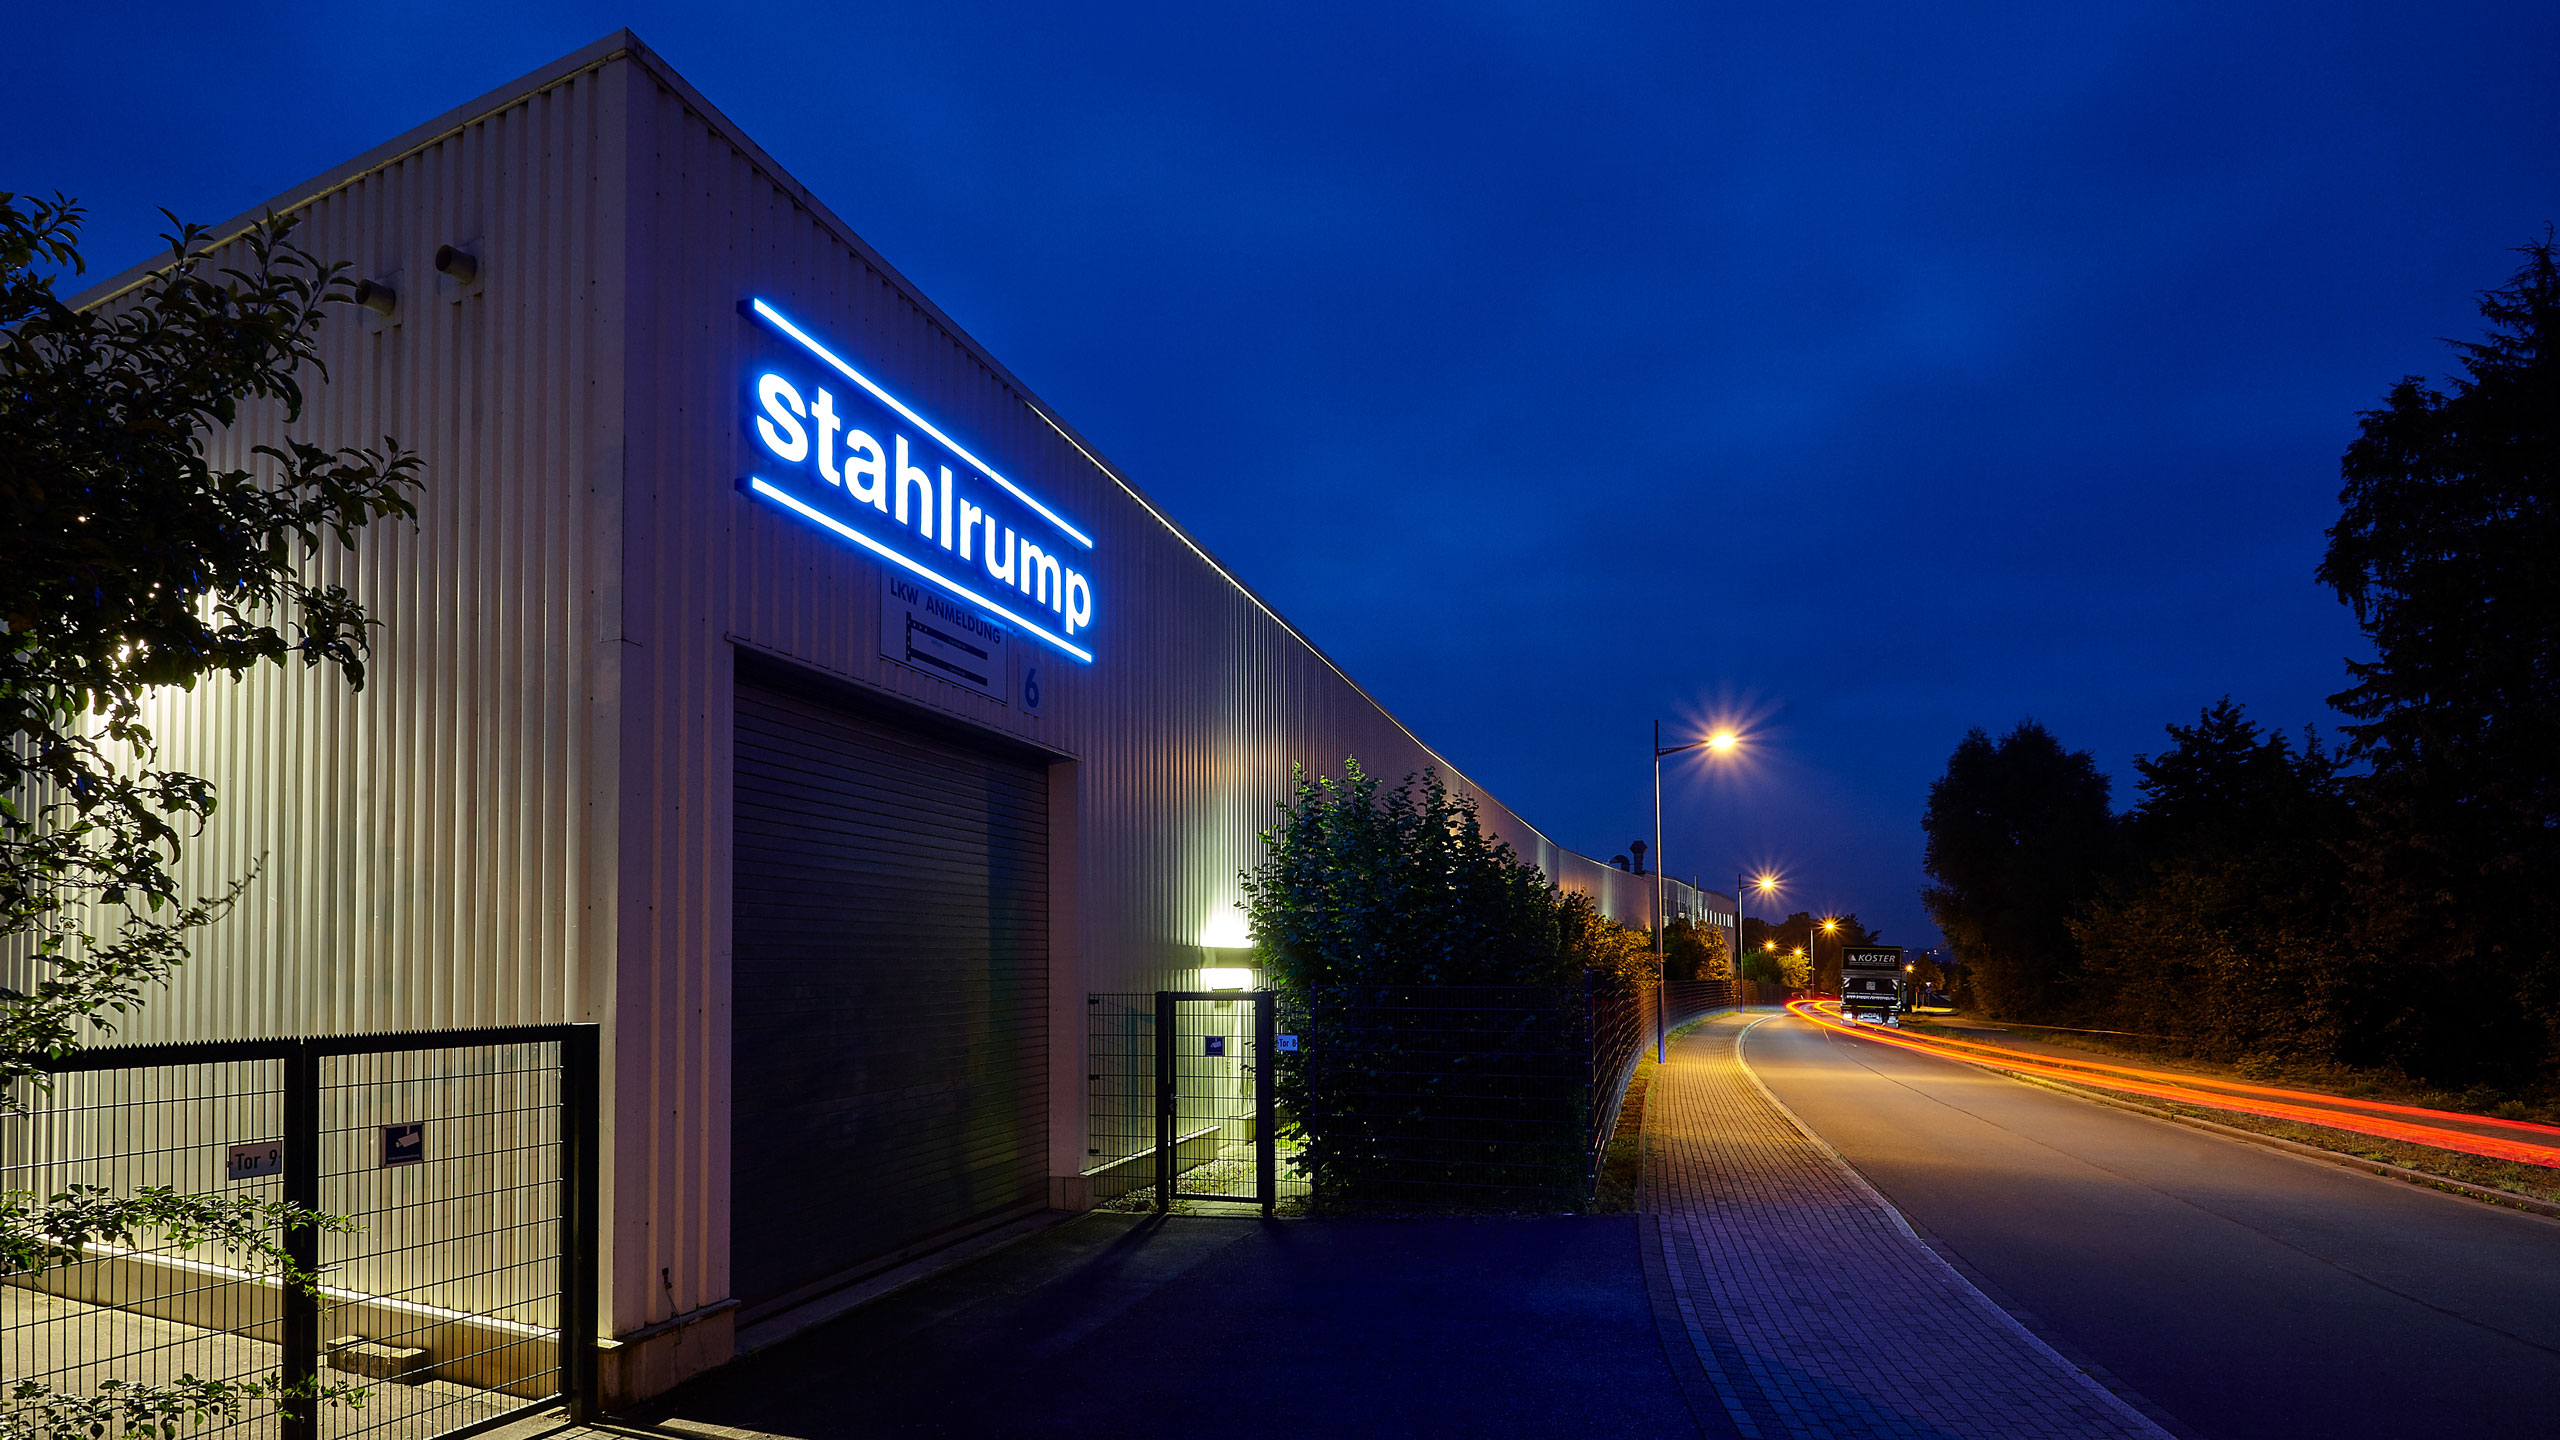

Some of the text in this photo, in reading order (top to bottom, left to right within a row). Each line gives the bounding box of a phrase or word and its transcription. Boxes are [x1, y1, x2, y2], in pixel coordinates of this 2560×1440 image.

[757, 373, 1092, 635] stahlrump
[890, 577, 1001, 644] LKW ANMELDUNG
[1025, 668, 1040, 709] 6
[1858, 952, 1896, 963] KÖSTER
[1279, 1038, 1290, 1048] Tor
[235, 1149, 278, 1171] Tor 9
